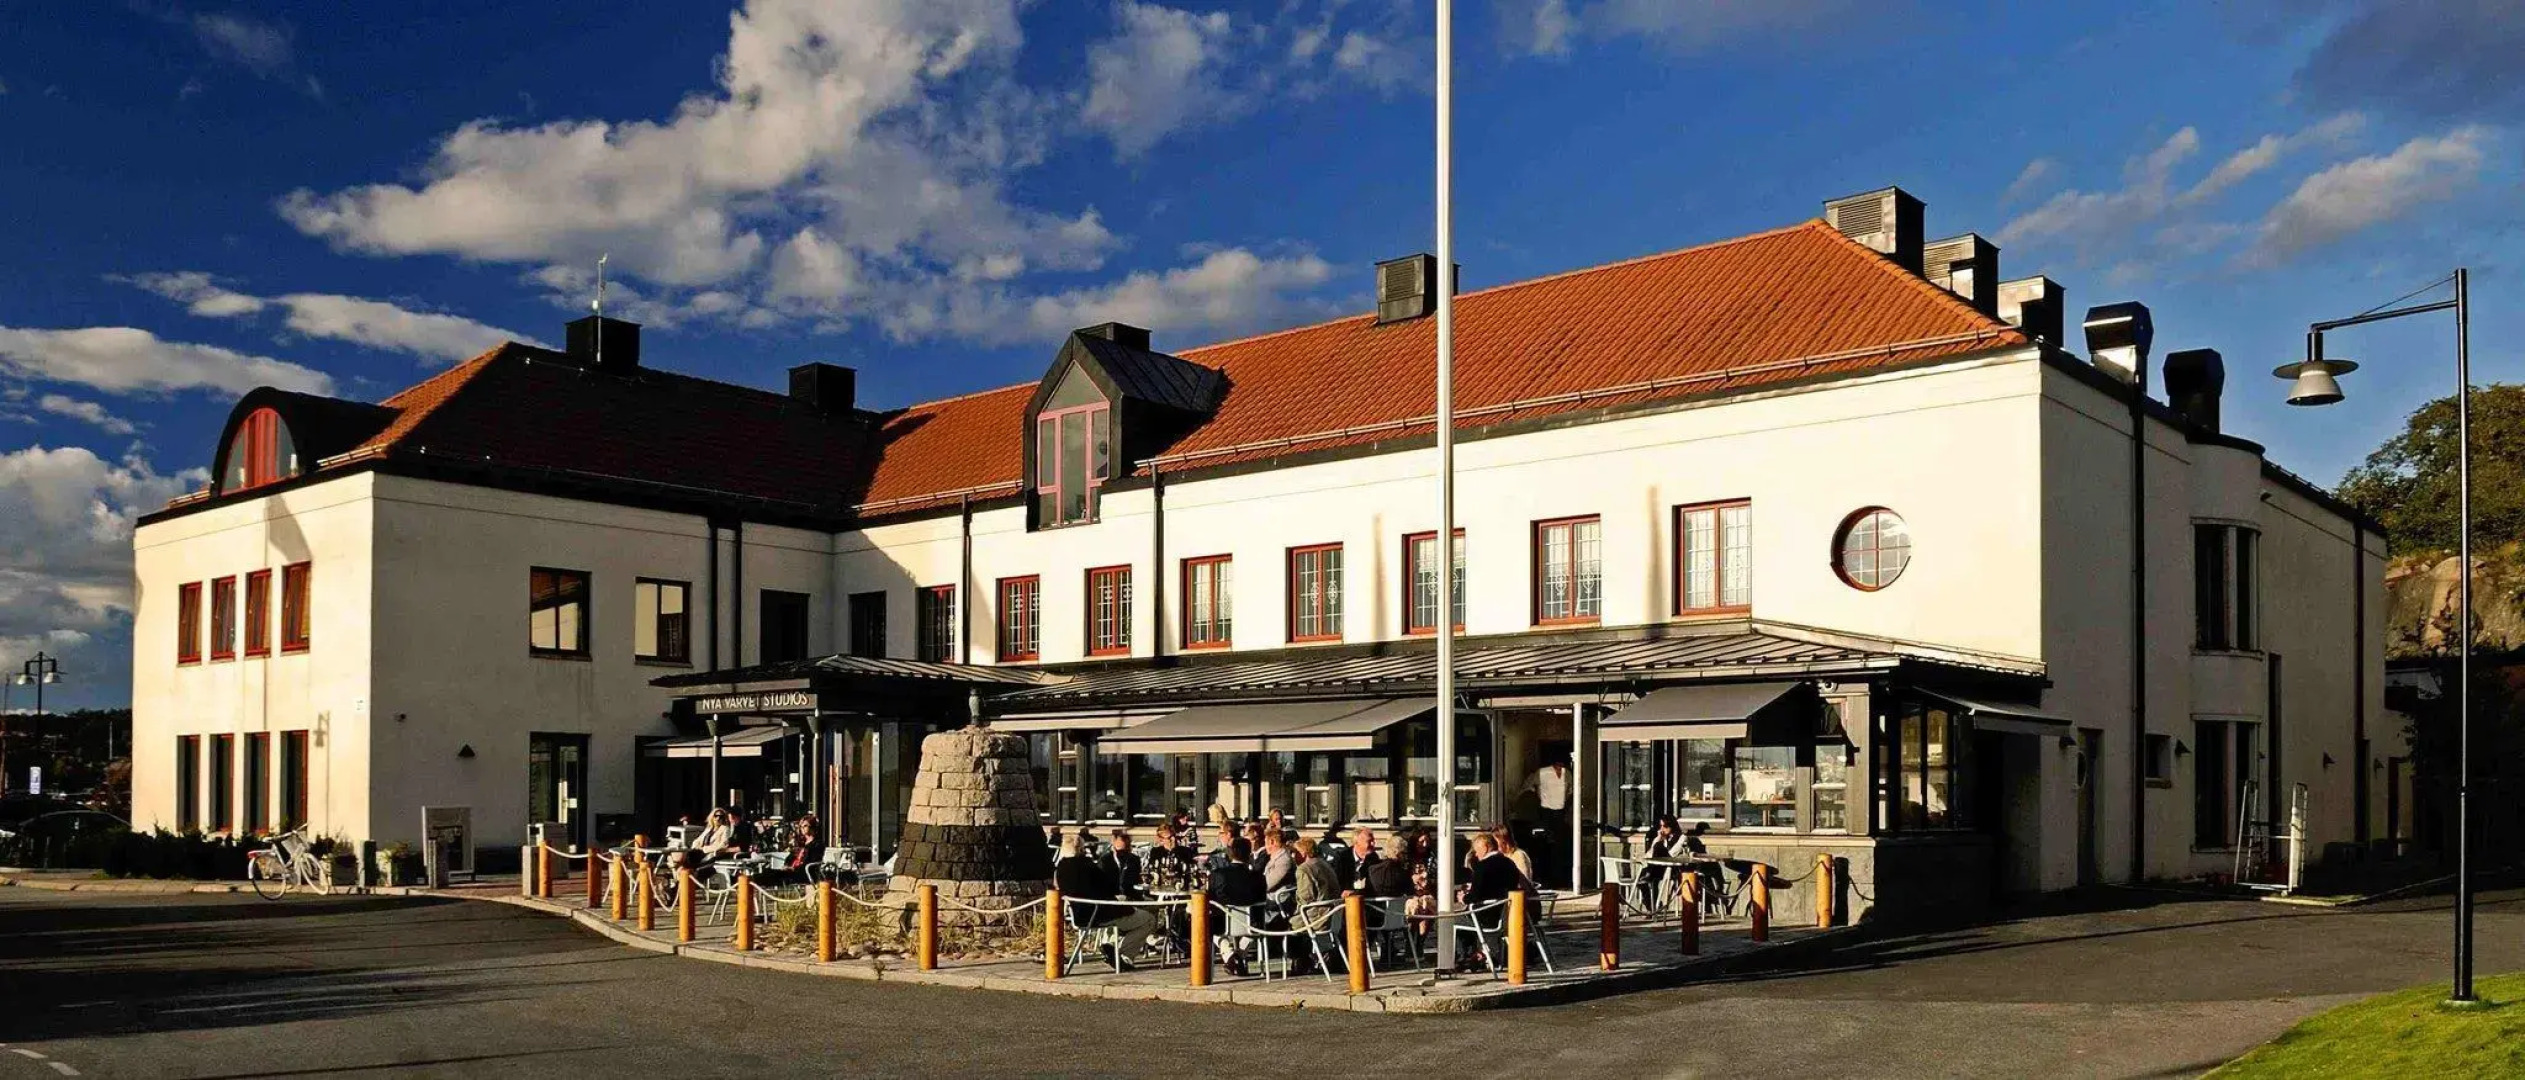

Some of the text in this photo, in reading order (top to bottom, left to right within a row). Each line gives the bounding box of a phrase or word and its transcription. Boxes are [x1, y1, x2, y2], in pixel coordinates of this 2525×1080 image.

[702, 692, 808, 710] NYA VARVET STUDIOS
